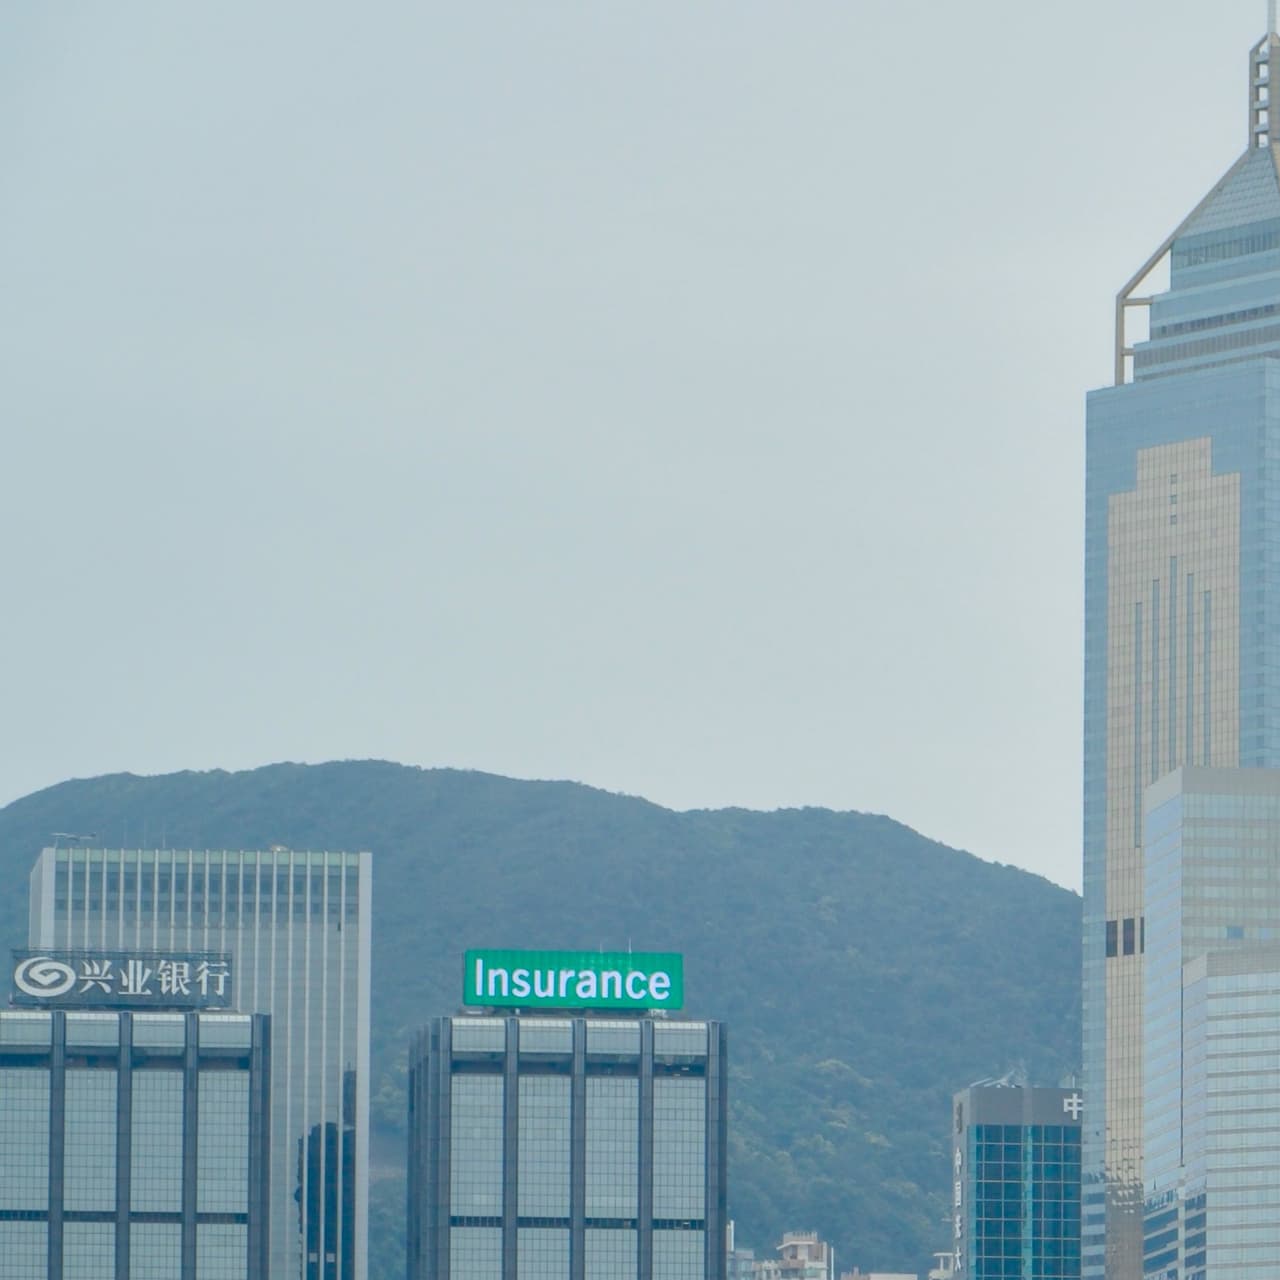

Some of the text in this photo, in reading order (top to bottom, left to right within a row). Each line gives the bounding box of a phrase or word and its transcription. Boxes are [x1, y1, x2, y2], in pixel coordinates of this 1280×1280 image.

[78, 958, 230, 997] 兴业银行
[475, 957, 671, 1000] Insurance
